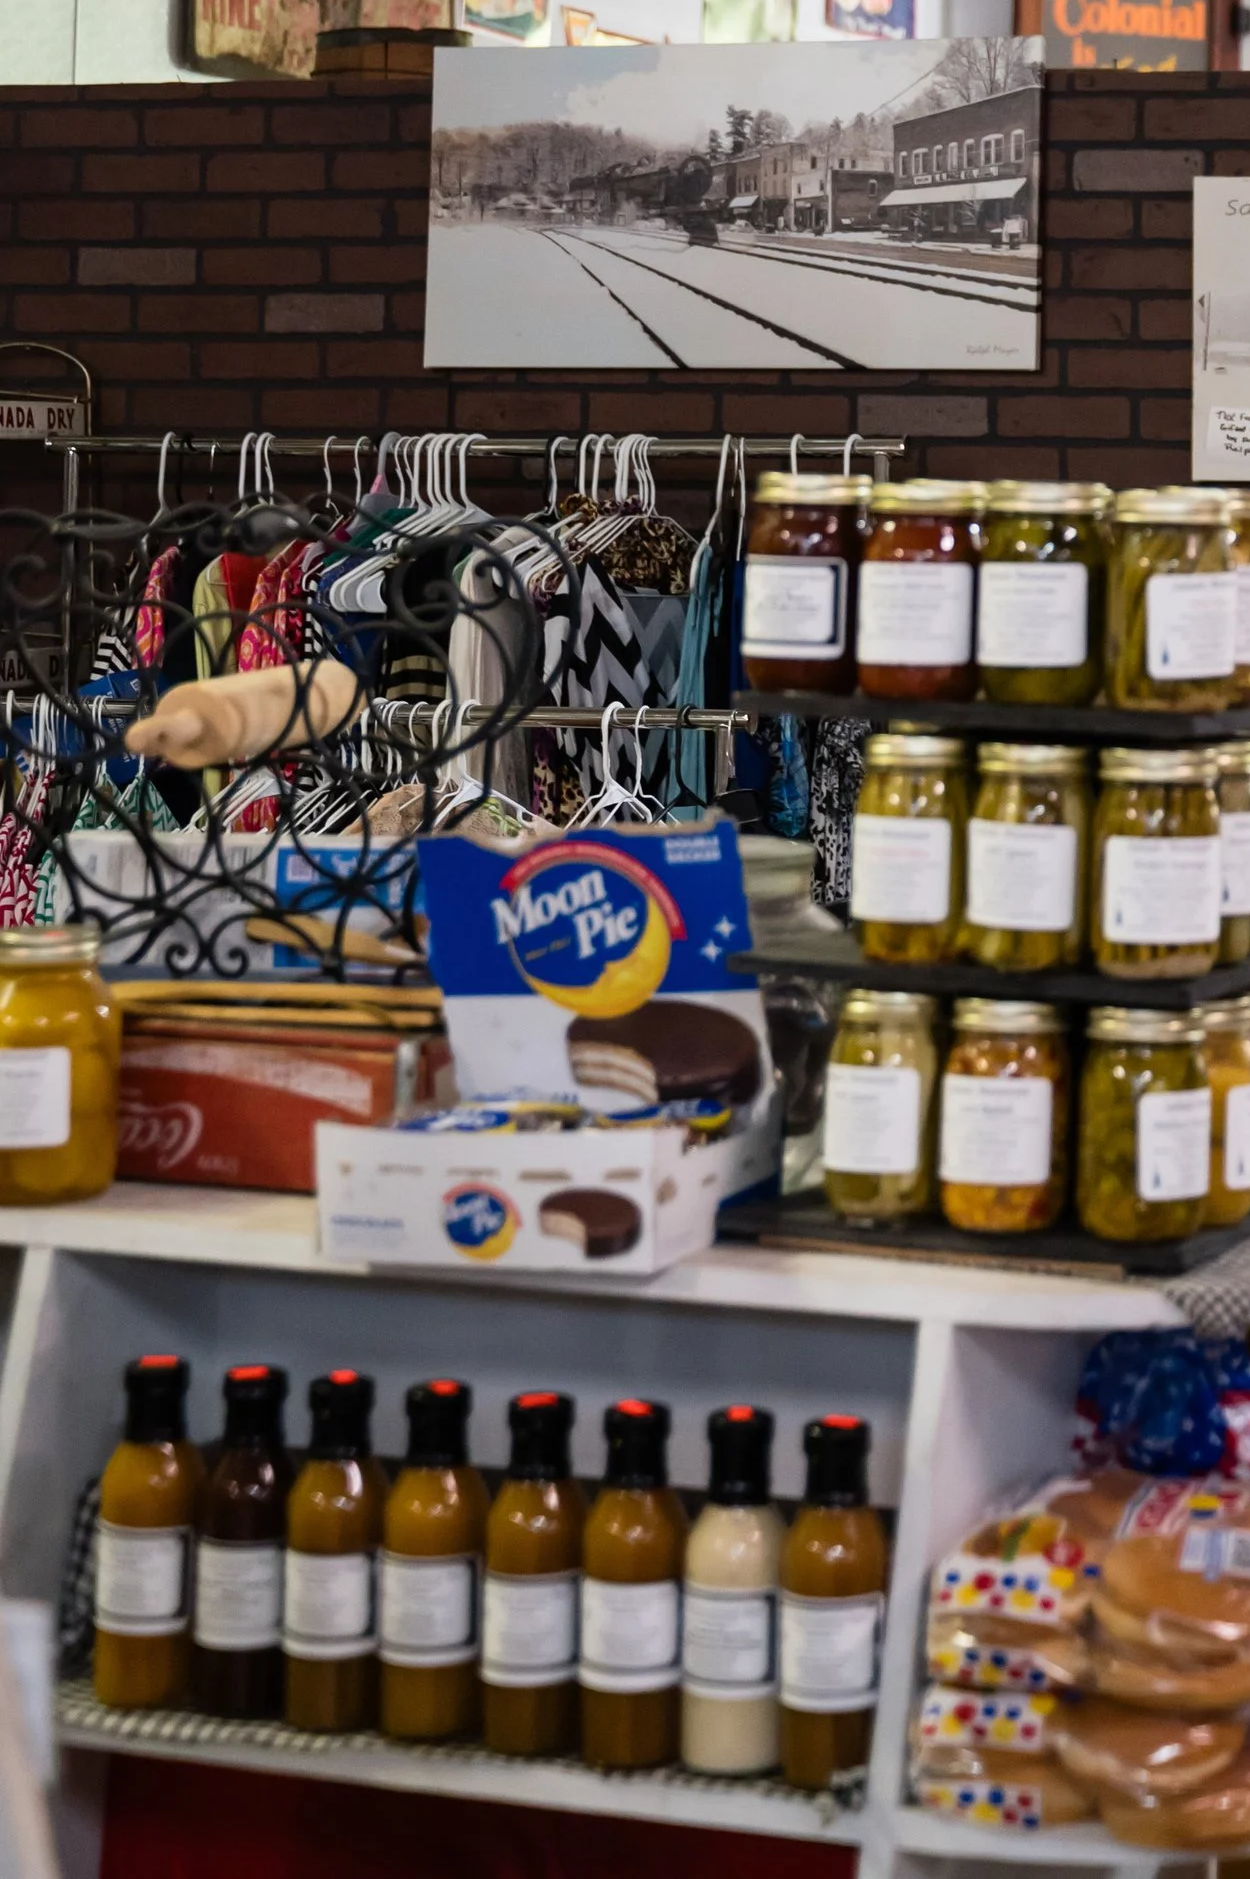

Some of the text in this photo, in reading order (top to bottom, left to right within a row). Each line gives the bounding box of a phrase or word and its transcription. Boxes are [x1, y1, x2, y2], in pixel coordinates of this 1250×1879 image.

[47, 407, 75, 430] DRY
[490, 869, 607, 944] Moon
[573, 900, 639, 960] Pie
